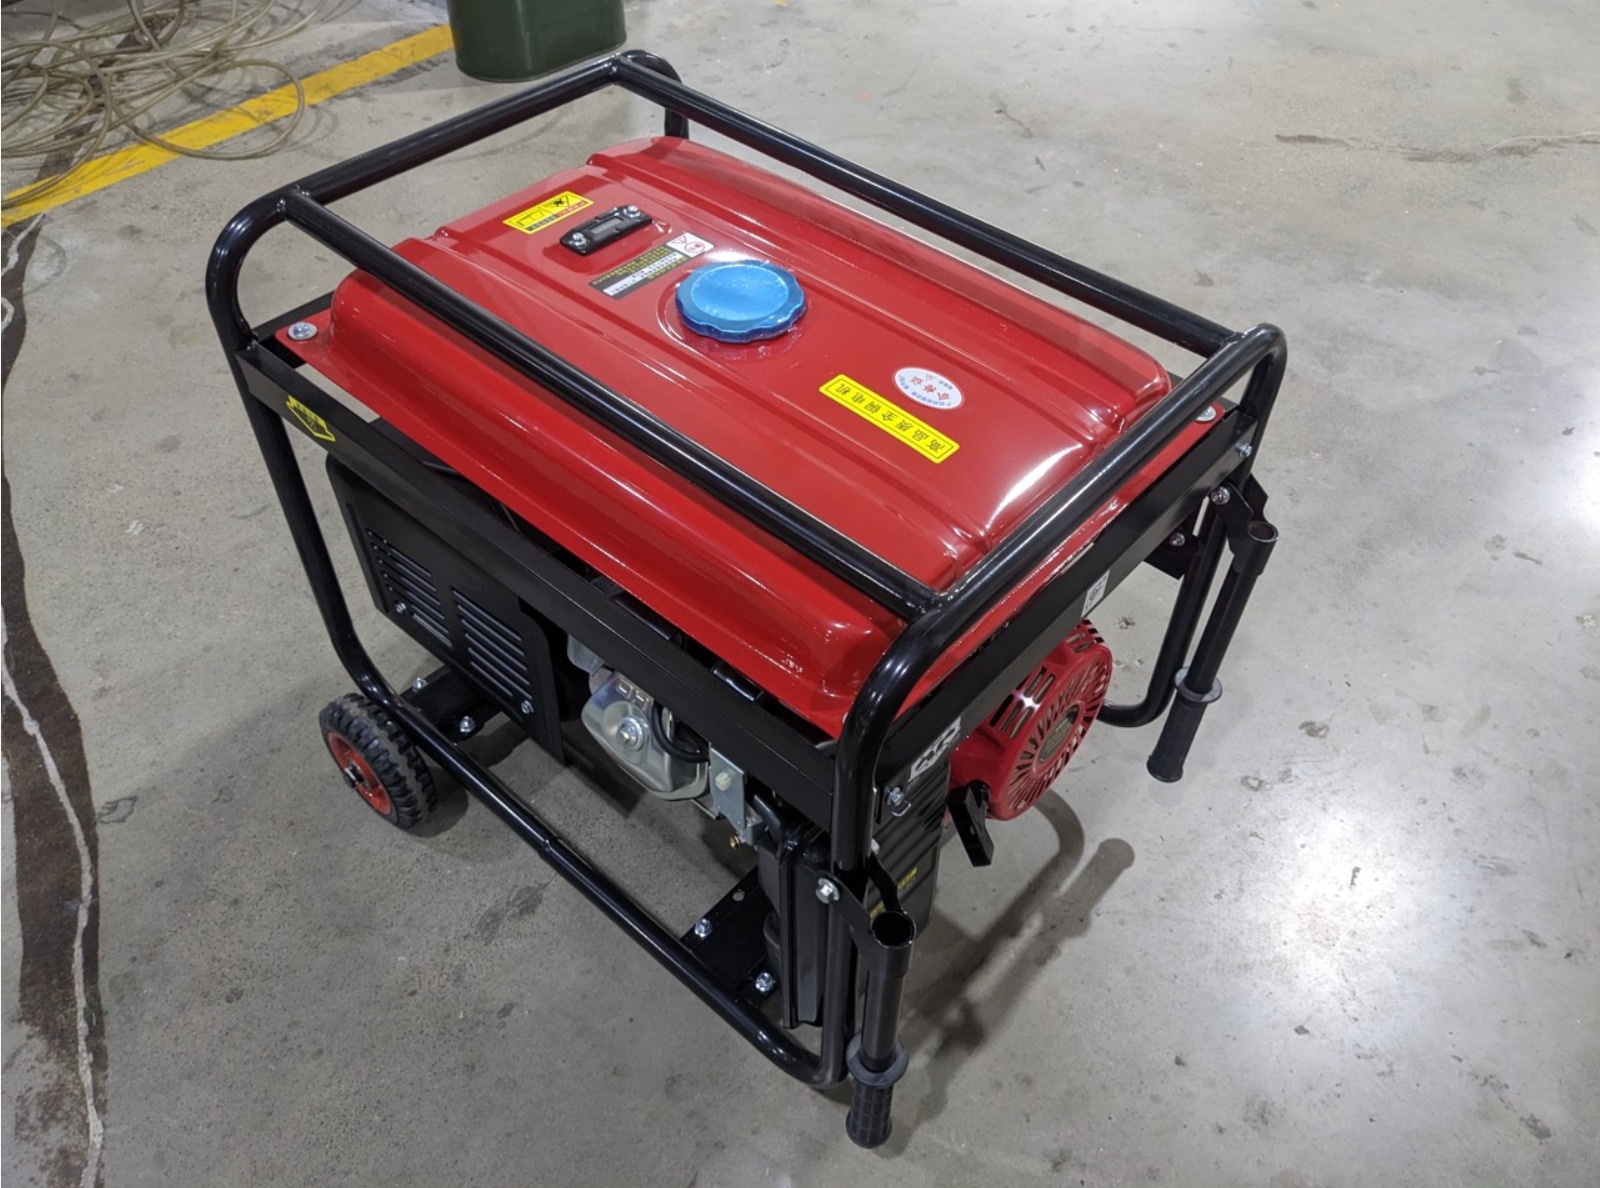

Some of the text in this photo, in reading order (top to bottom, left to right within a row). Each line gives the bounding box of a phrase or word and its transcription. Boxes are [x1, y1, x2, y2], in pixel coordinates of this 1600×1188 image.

[835, 383, 946, 453] 高品质全铜电机
